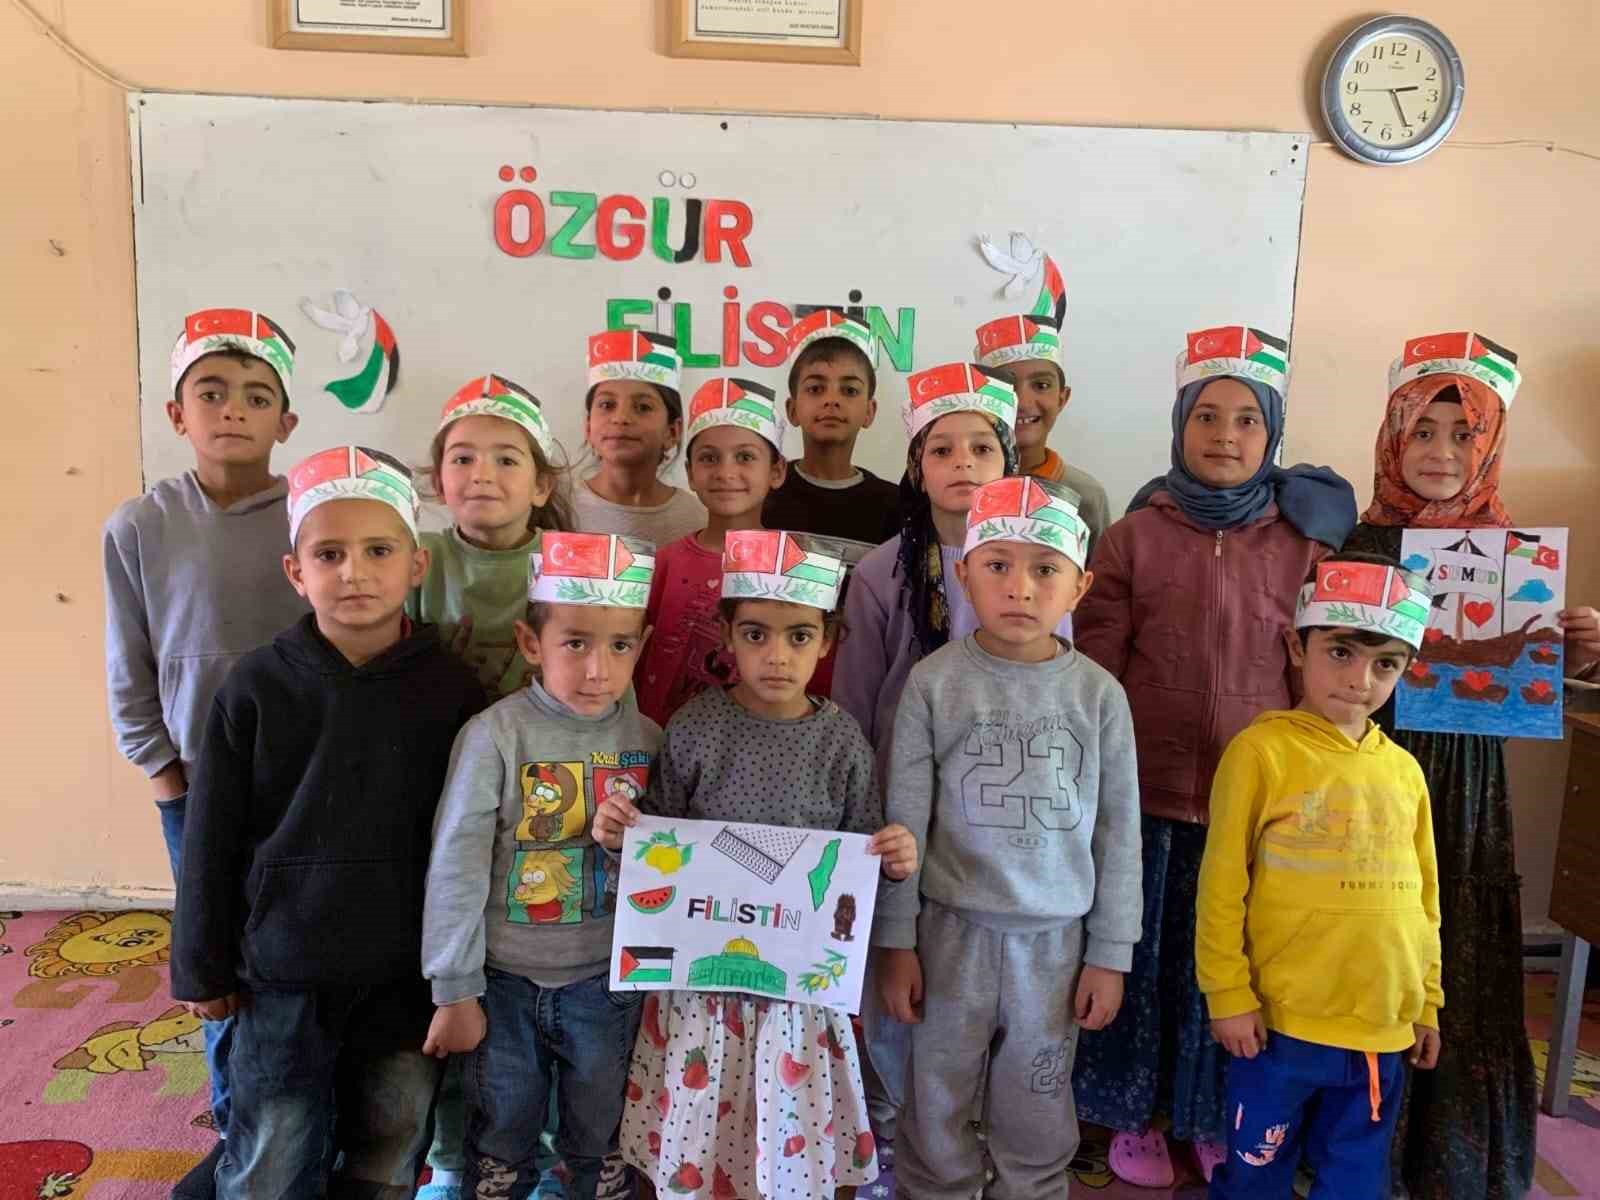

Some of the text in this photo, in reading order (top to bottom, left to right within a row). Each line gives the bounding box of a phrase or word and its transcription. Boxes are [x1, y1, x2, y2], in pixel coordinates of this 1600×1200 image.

[1372, 45, 1384, 60] 11
[1391, 42, 1408, 57] 12
[1415, 49, 1421, 63] 1
[1353, 60, 1369, 75] 10
[1425, 66, 1437, 81] 2
[1346, 80, 1359, 95] 9
[1426, 88, 1439, 103] 3
[1350, 102, 1361, 116] 8
[1417, 110, 1429, 123] 4
[1361, 120, 1373, 134] 7
[1380, 126, 1392, 141] 6
[1401, 124, 1414, 139] 5
[493, 165, 753, 268] ÖZGÜR
[606, 286, 917, 373] FİLİSN
[961, 722, 1084, 832] 23
[687, 895, 802, 931] FİLİSTİN
